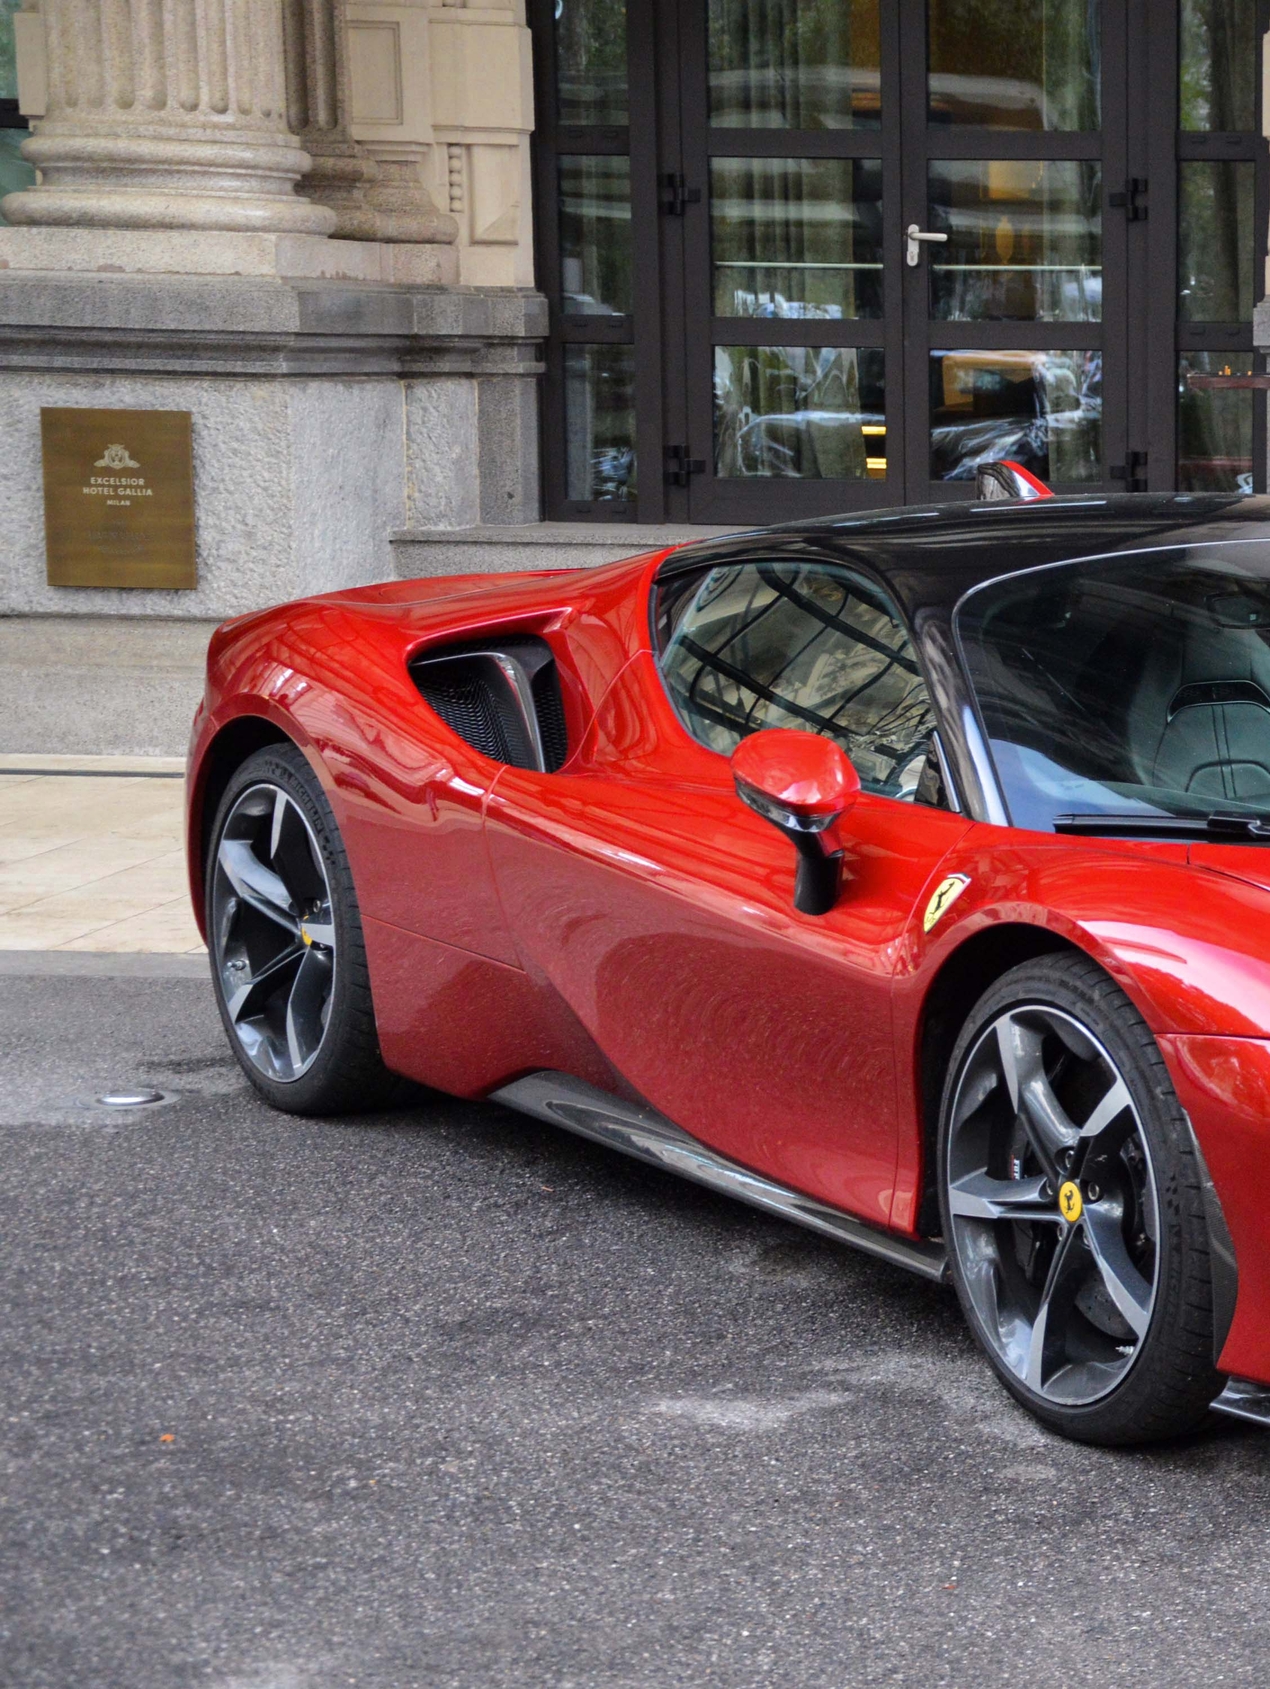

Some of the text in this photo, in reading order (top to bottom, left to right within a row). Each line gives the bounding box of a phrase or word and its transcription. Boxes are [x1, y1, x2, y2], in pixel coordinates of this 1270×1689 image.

[90, 477, 145, 485] EXCELSIOR
[83, 487, 153, 496] HOTEL GALLIA
